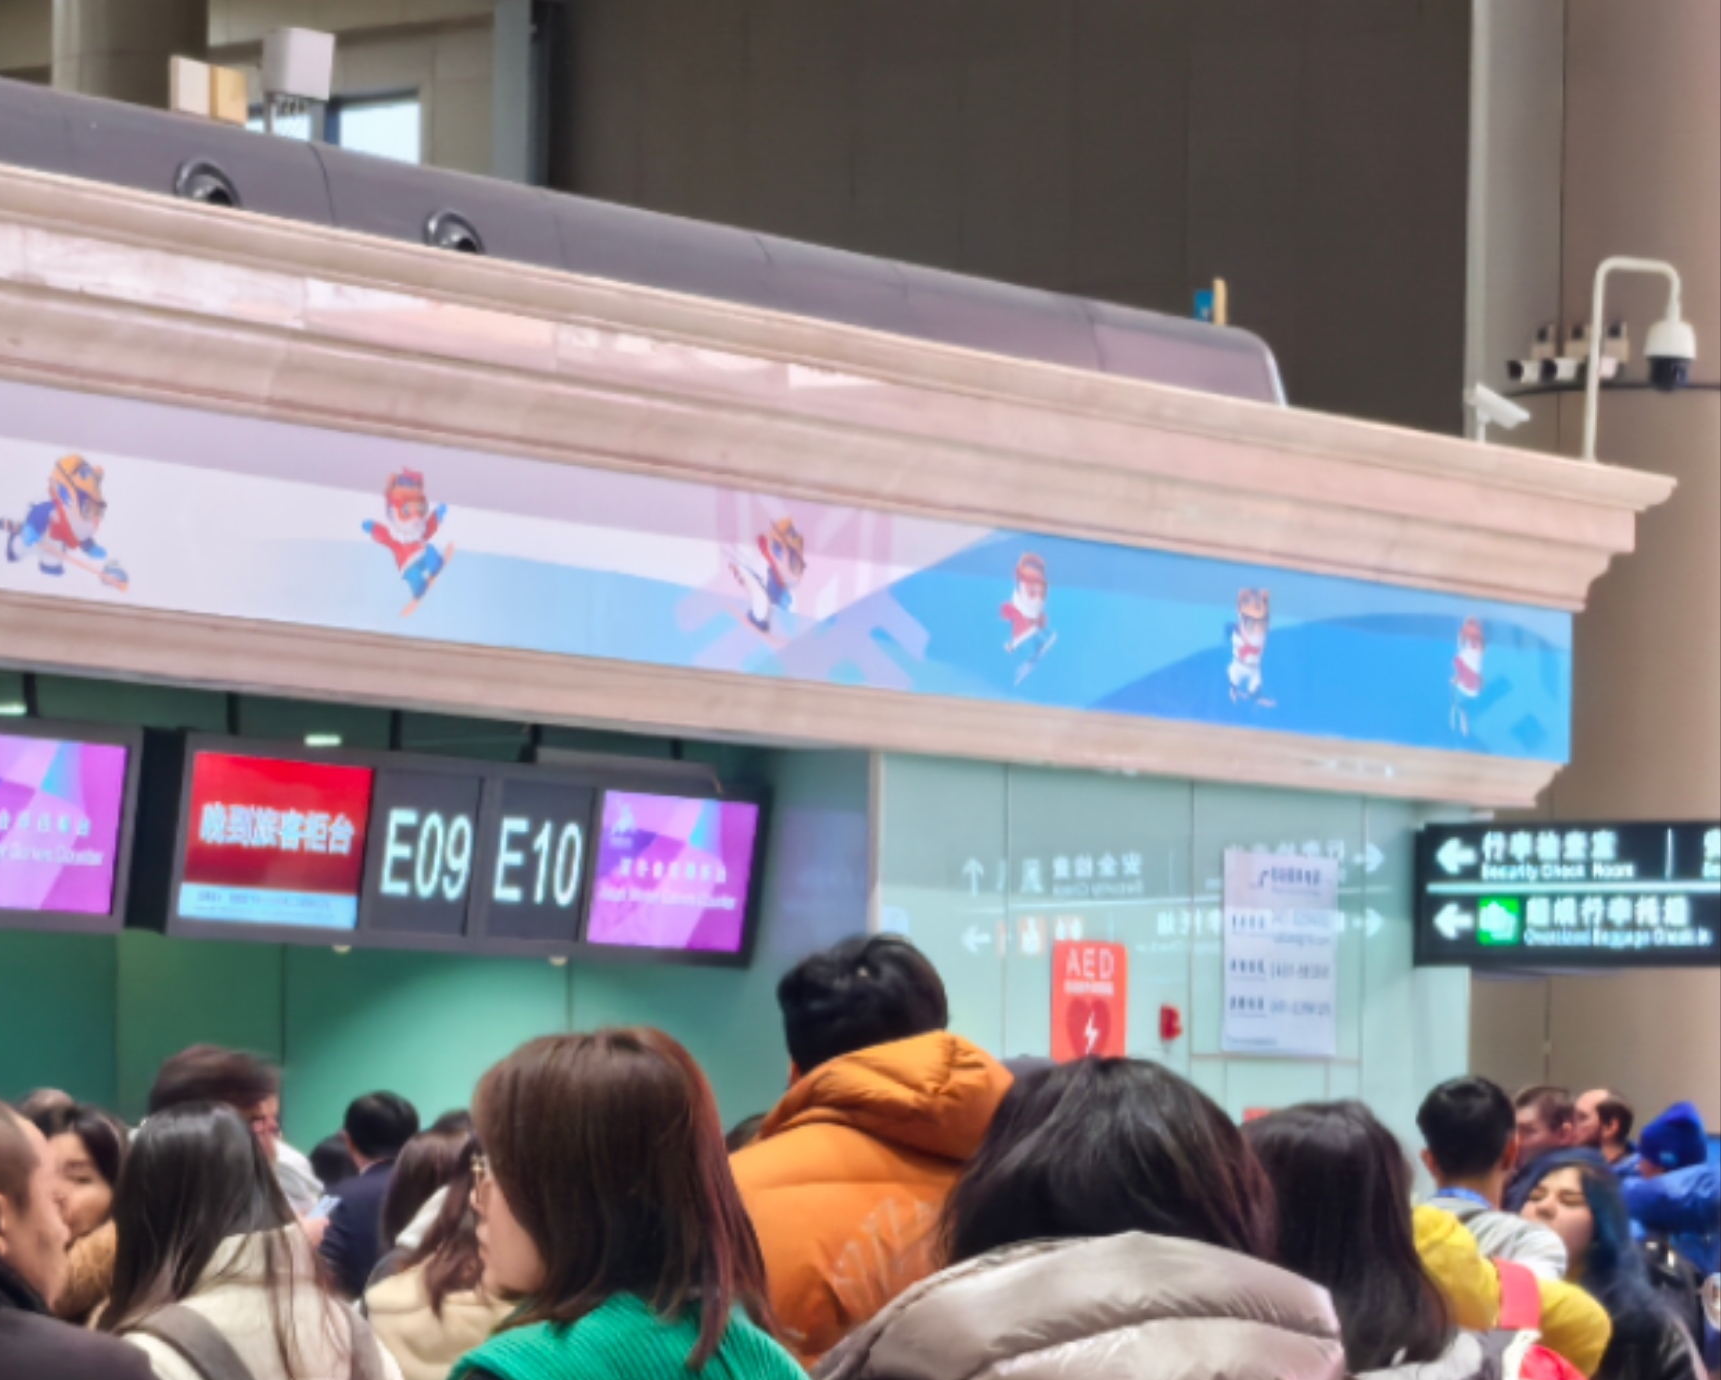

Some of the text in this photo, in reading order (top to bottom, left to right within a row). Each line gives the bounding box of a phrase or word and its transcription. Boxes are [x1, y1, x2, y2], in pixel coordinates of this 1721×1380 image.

[380, 808, 472, 900] E09
[493, 817, 582, 906] E10
[1066, 947, 1115, 980] AED
